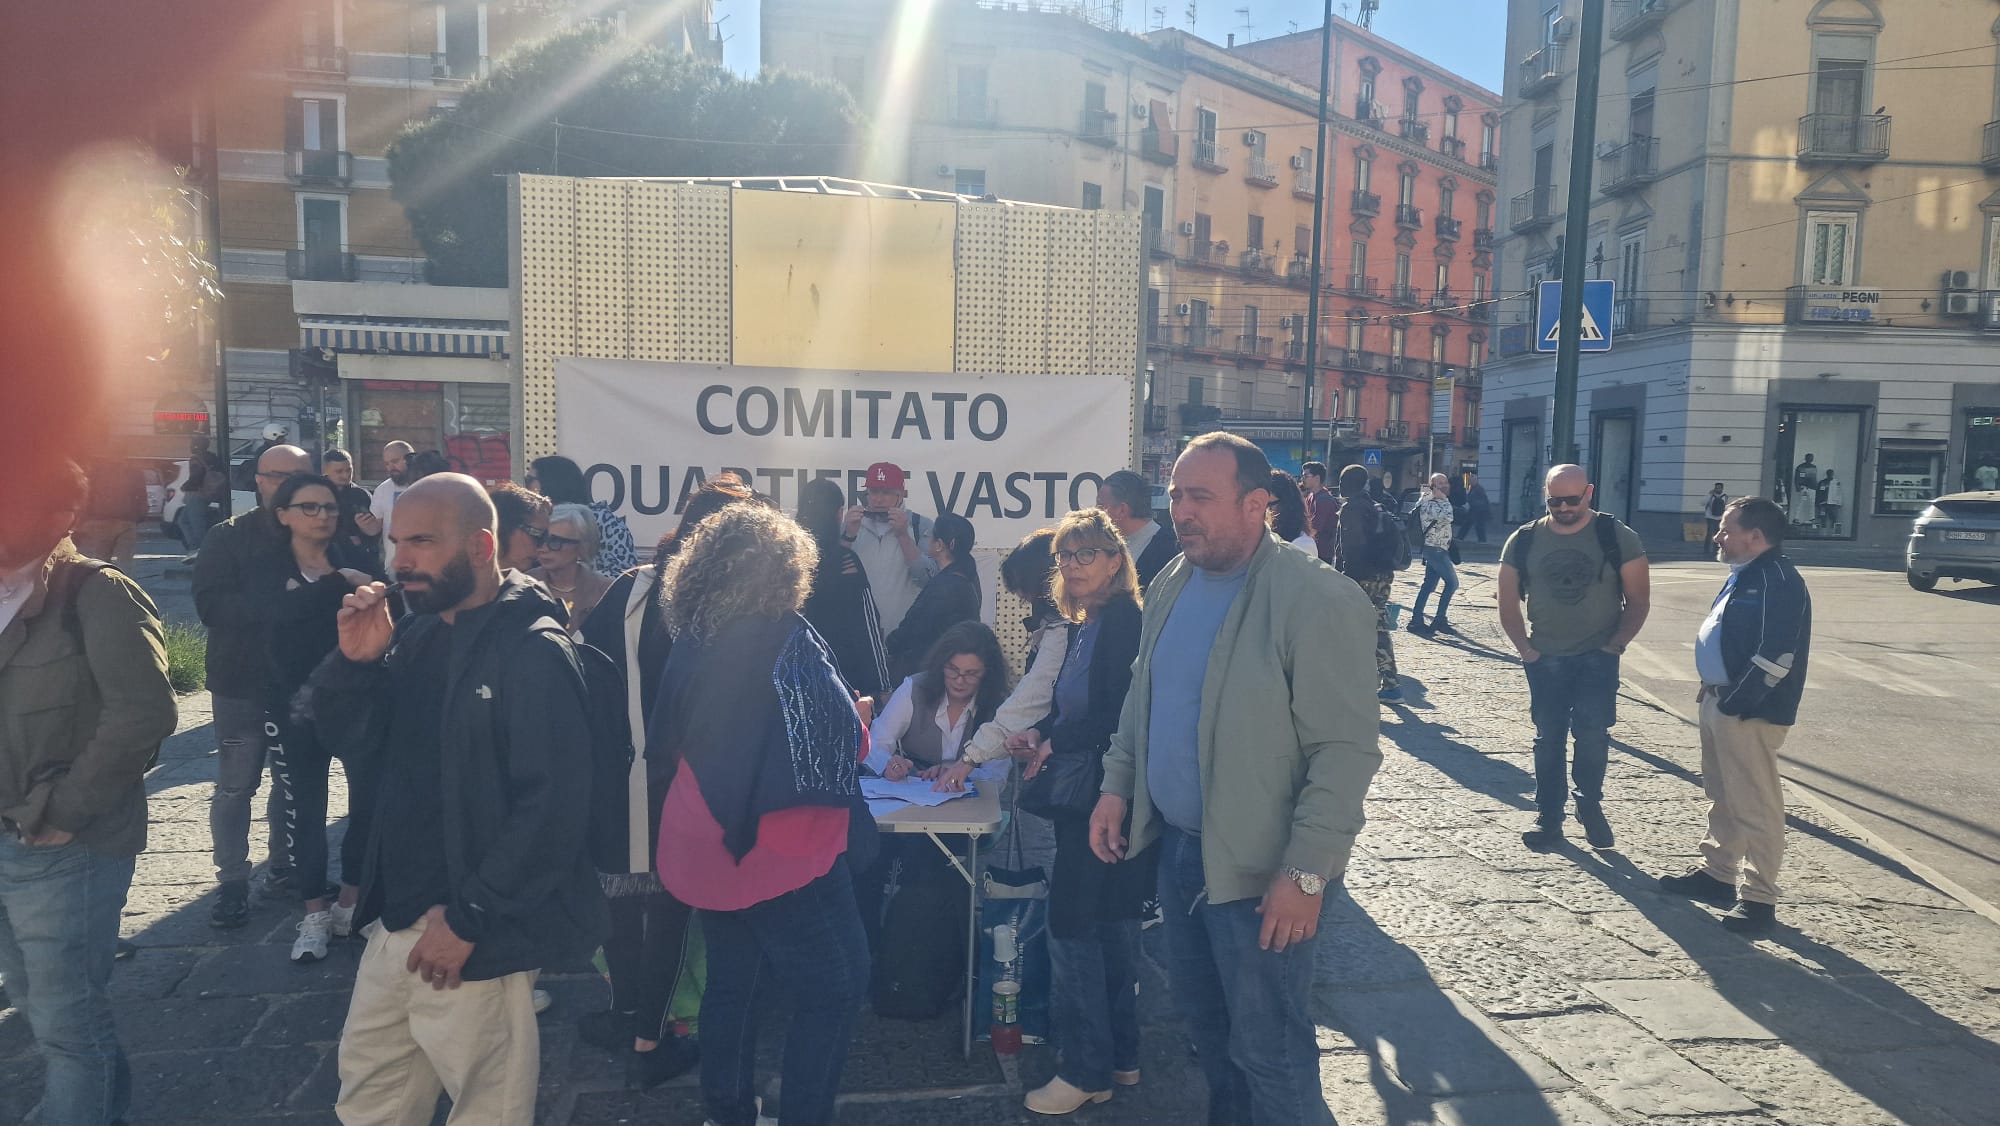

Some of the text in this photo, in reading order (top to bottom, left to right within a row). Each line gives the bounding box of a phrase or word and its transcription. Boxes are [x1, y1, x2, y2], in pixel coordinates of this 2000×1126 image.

[1842, 292, 1880, 304] PEGNI
[696, 384, 1008, 441] COMITATO
[583, 463, 1104, 520] QUATIR VASTO
[264, 709, 297, 868] OTIVATION
